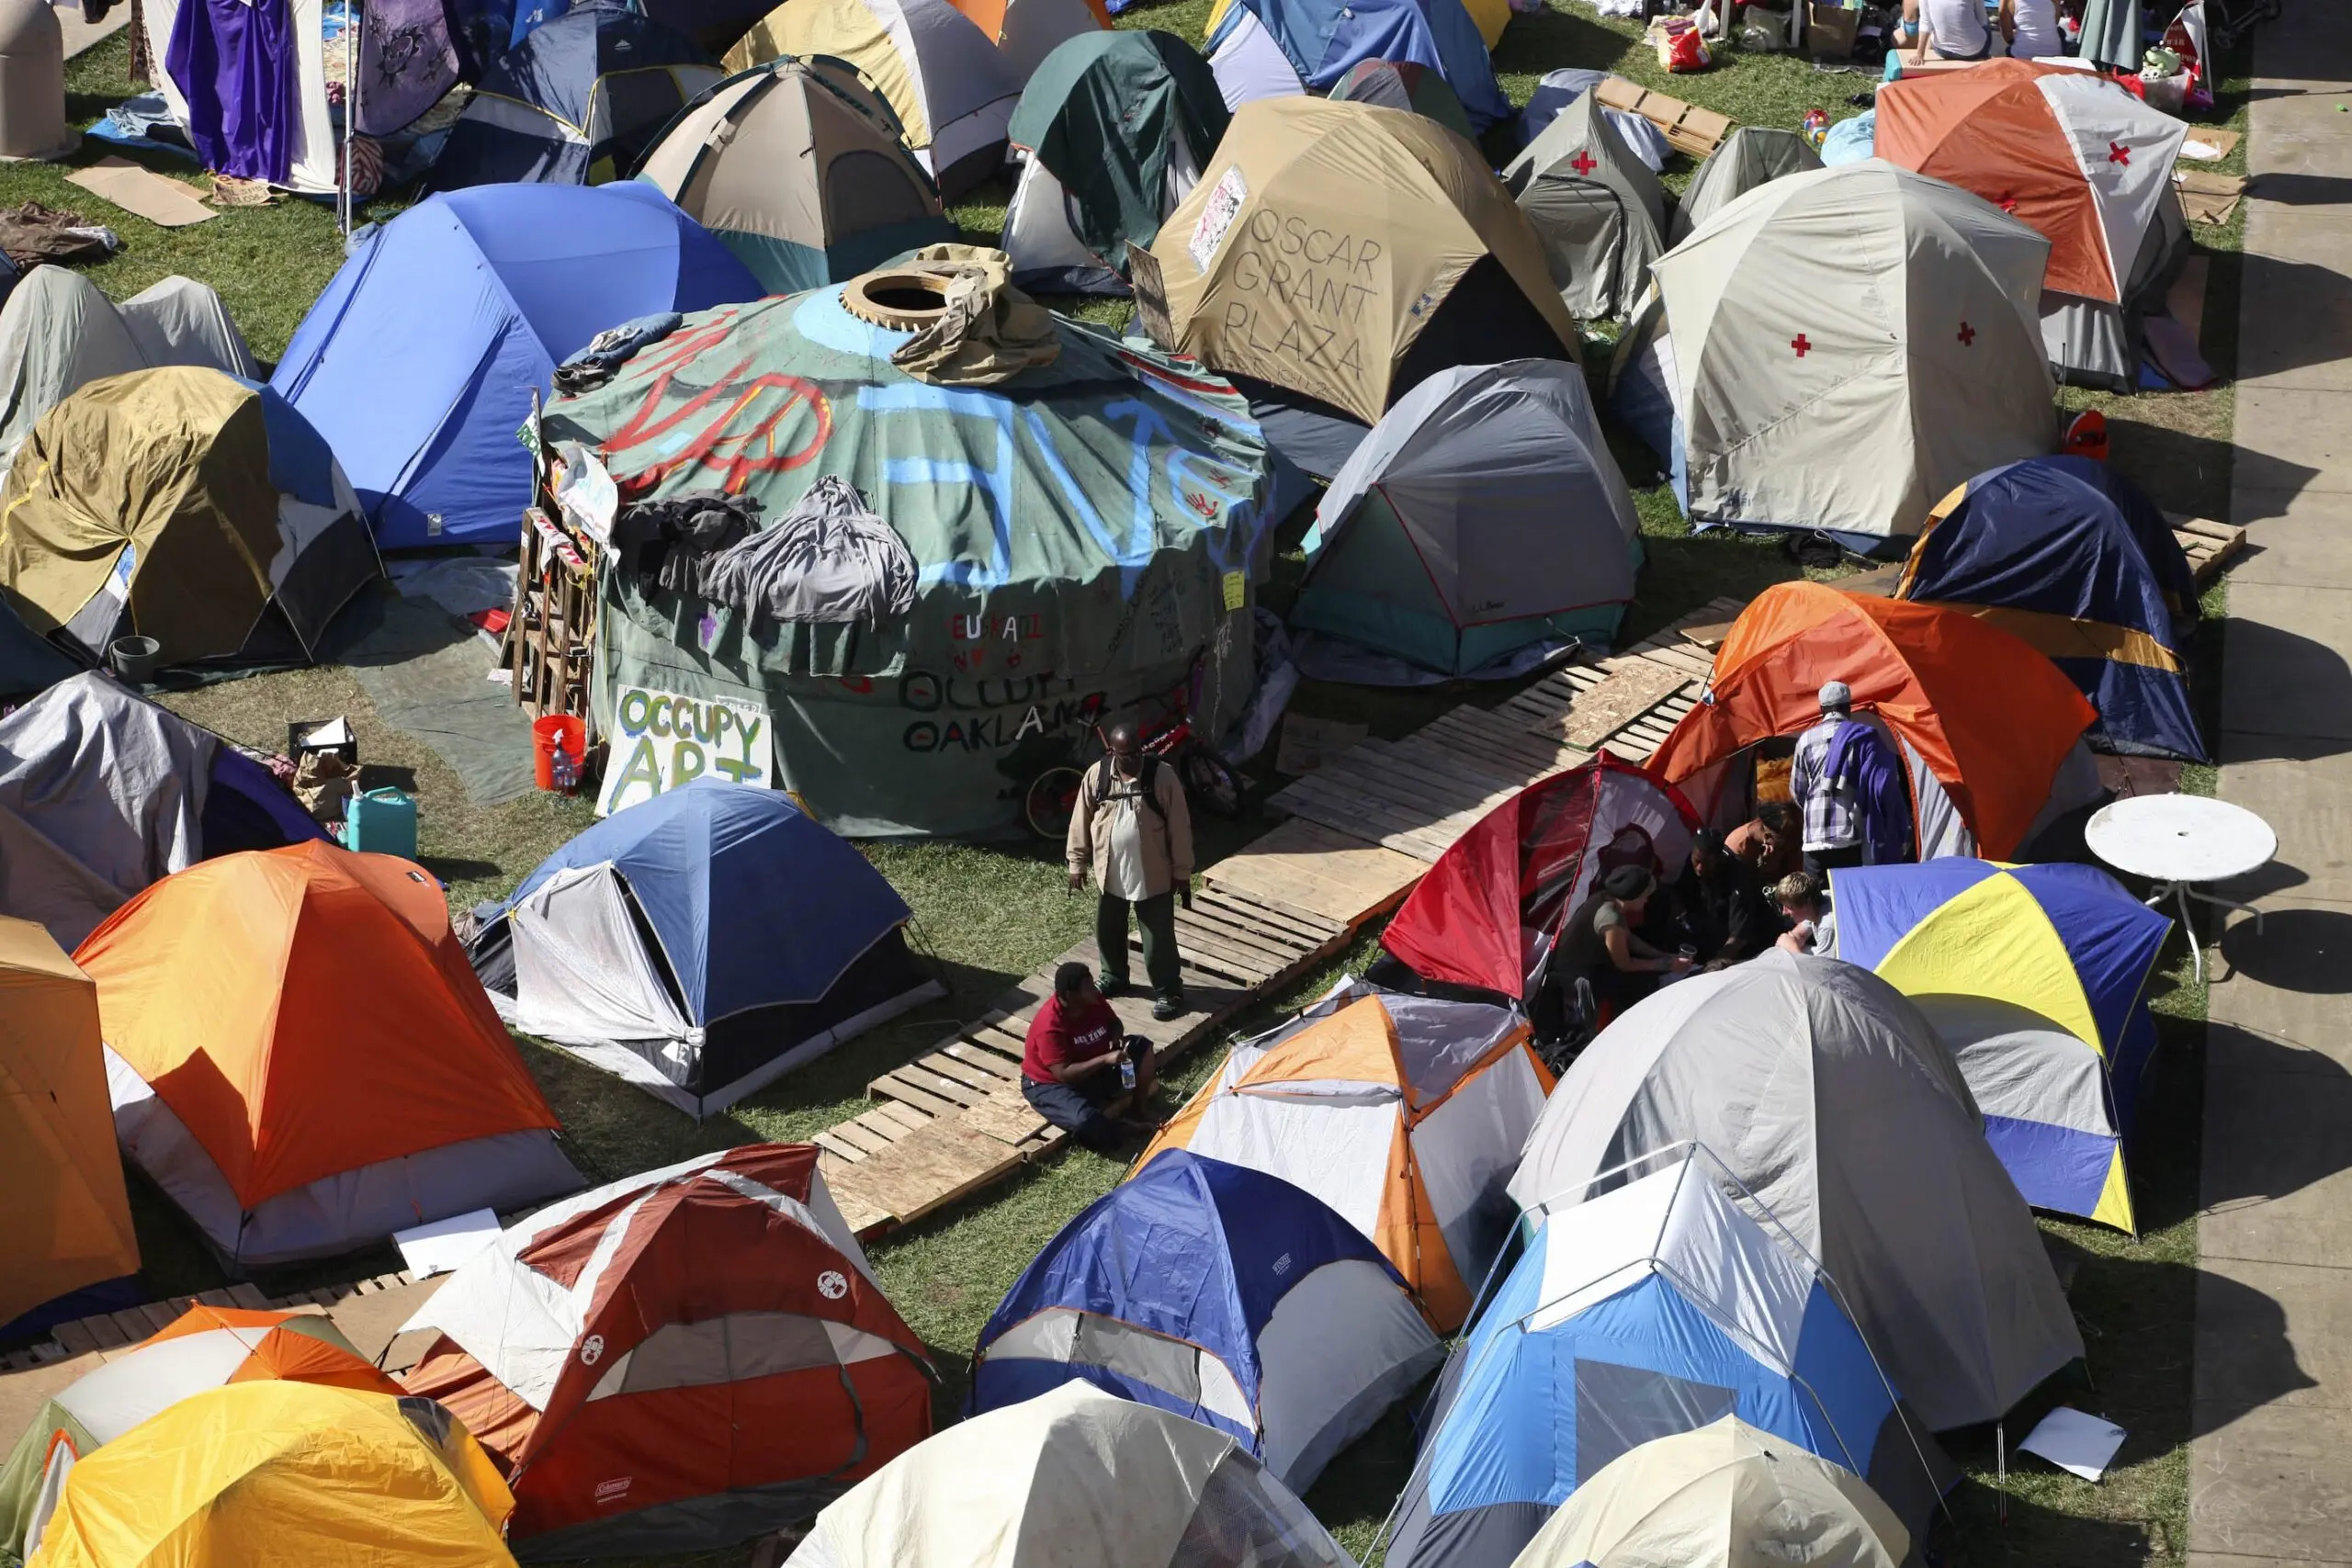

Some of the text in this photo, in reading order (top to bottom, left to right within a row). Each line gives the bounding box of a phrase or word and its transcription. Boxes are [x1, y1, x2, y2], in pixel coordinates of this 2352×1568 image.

[1251, 208, 1381, 281] OSCAR
[1233, 251, 1379, 324] GRANT
[1224, 301, 1363, 381] PLAZA
[618, 688, 762, 766] OCCUPY
